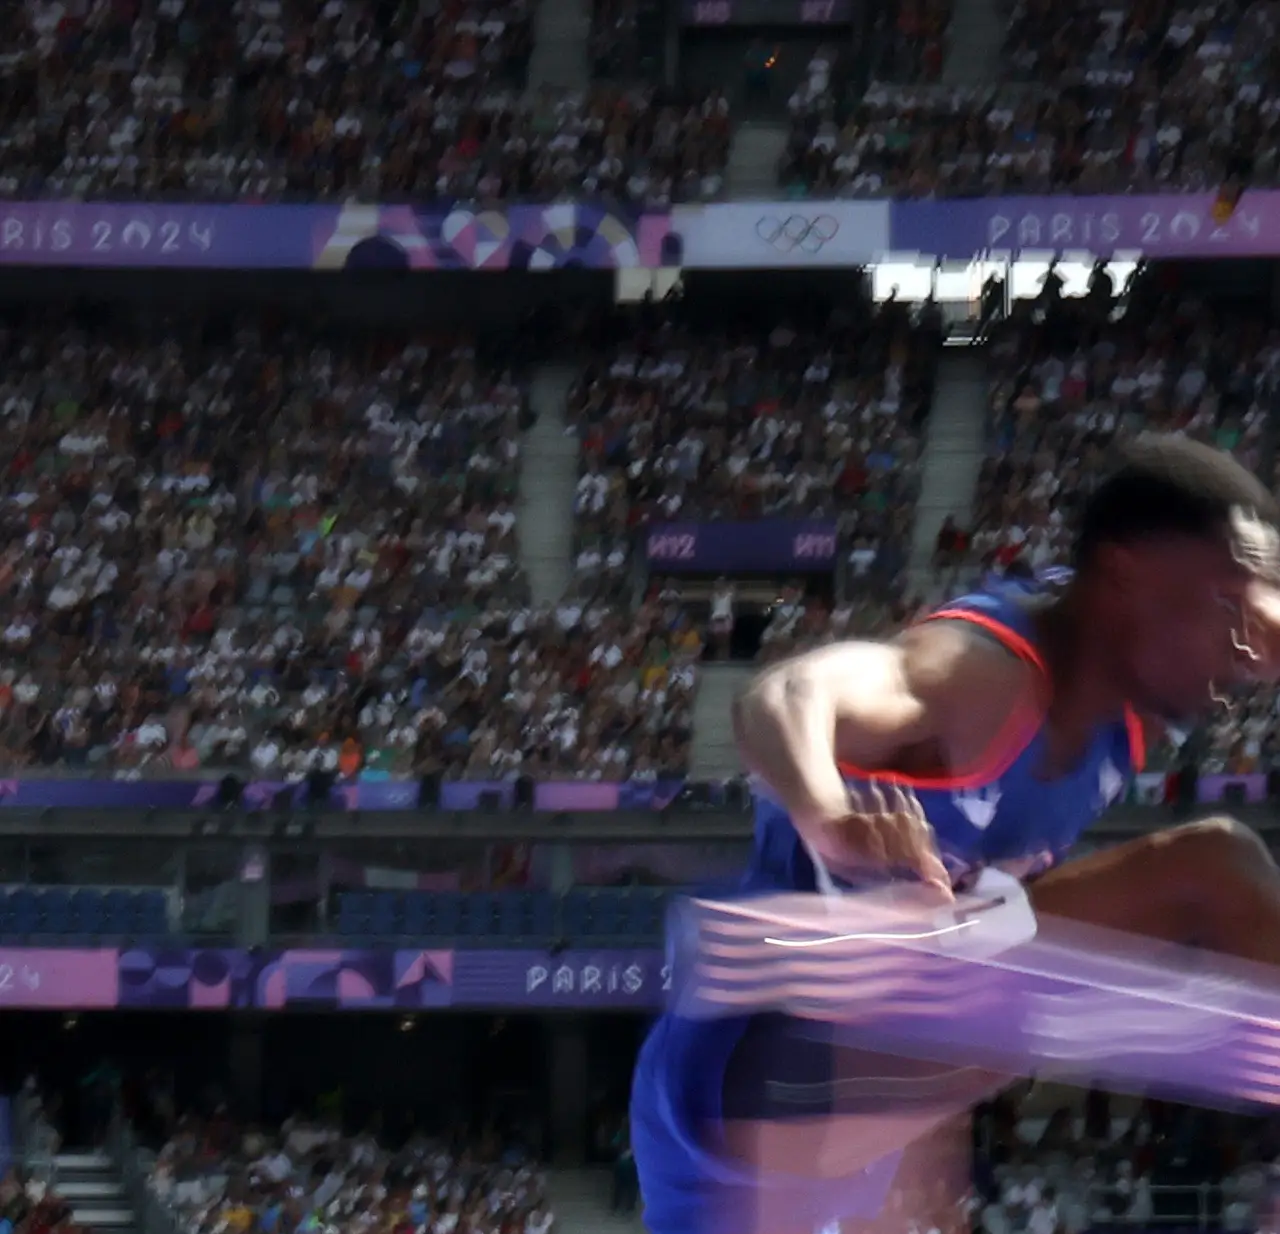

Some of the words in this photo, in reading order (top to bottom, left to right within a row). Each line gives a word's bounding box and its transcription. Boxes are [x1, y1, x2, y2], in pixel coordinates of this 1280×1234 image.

[91, 219, 211, 252] 2024
[989, 214, 1121, 249] PARIS
[526, 964, 643, 994] PARIS
